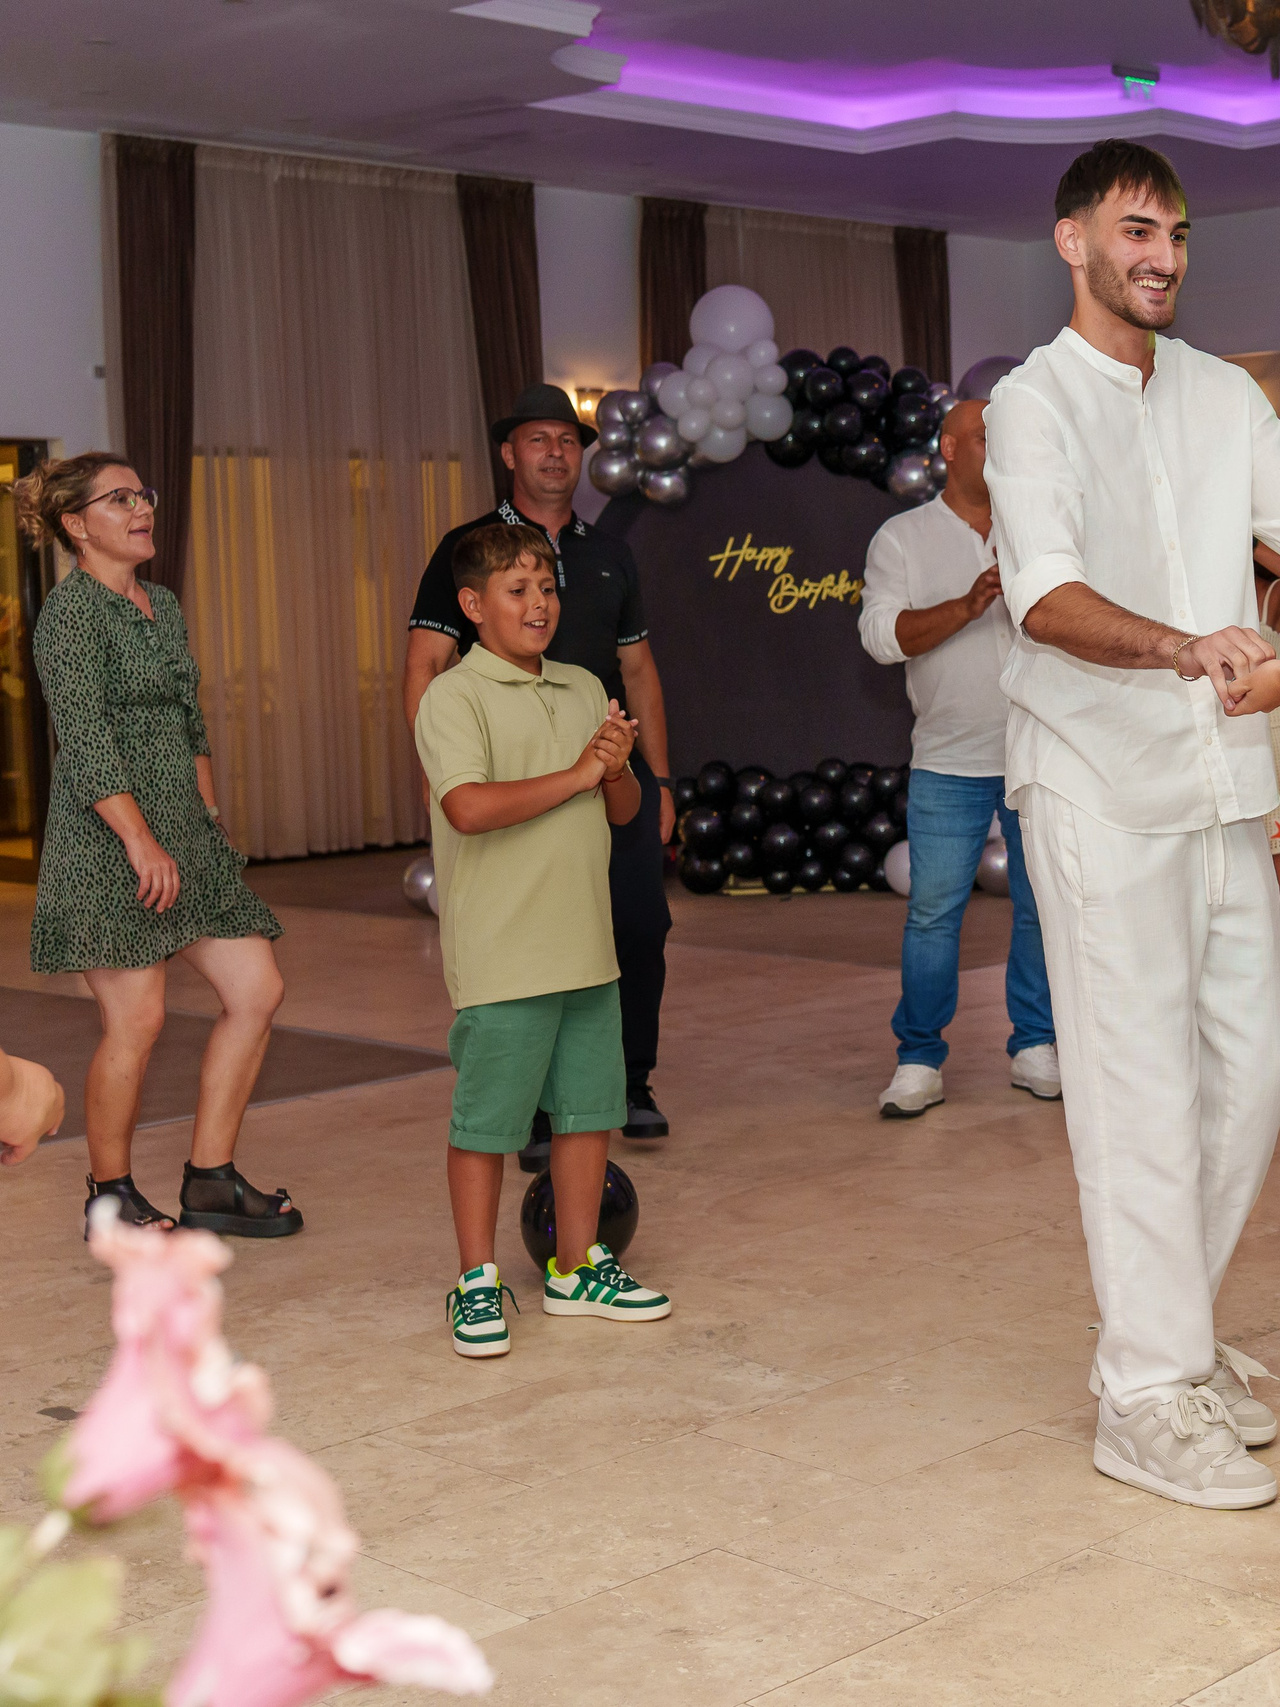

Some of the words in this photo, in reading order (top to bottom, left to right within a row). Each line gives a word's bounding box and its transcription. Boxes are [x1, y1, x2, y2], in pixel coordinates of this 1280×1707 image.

[708, 532, 794, 575] Happy
[767, 570, 866, 614] Birthday
[419, 619, 442, 630] HUGO
[443, 625, 461, 639] BOS
